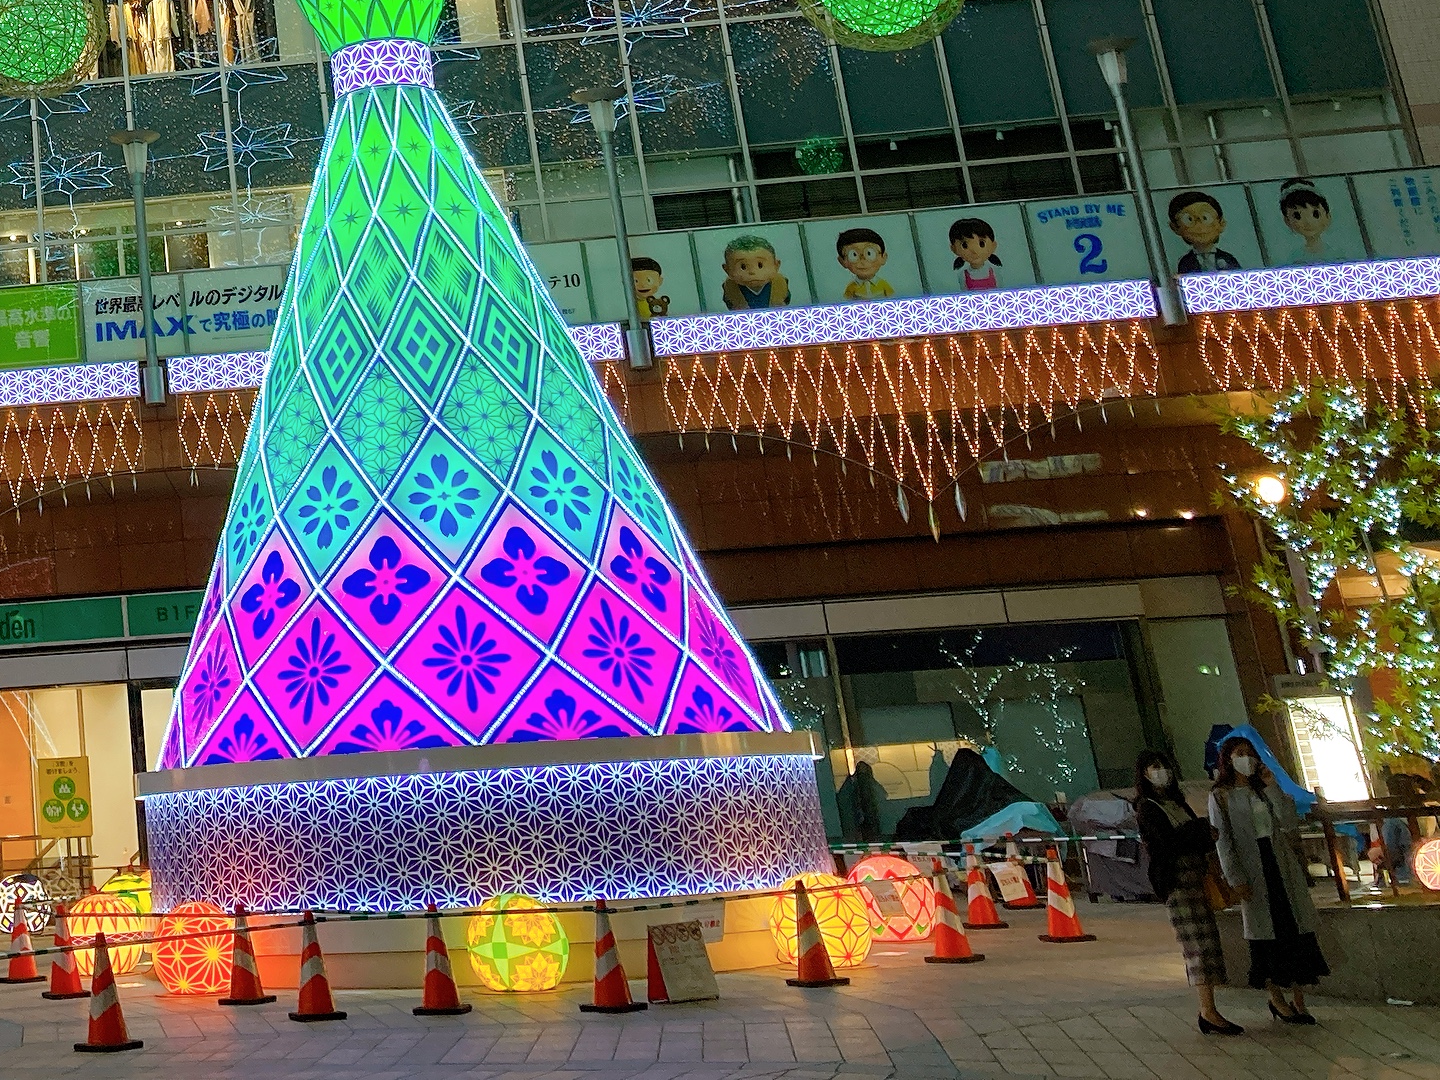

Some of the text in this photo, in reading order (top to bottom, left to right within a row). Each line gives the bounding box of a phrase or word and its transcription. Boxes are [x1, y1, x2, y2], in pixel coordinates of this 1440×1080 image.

[1037, 205, 1079, 224] STAND
[1084, 203, 1101, 214] BY
[1106, 204, 1126, 217] ME
[1073, 233, 1108, 274] 2
[157, 605, 195, 622] B1F
